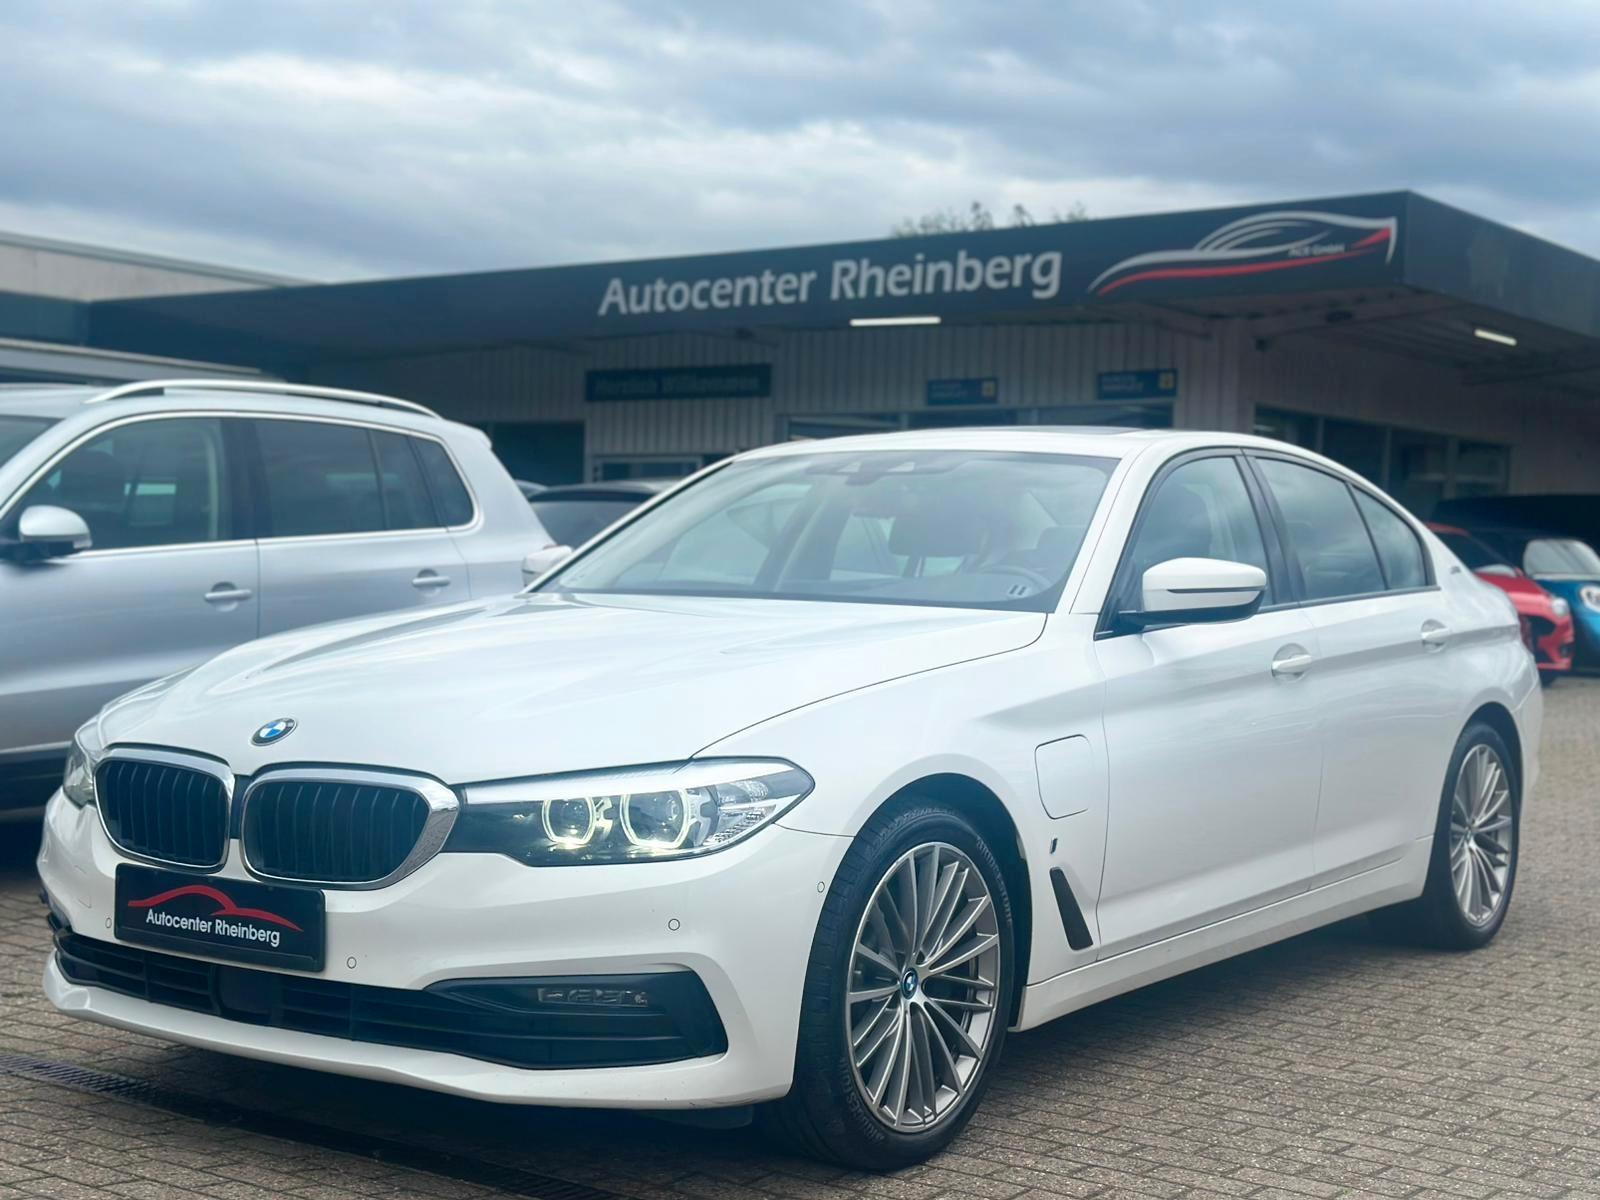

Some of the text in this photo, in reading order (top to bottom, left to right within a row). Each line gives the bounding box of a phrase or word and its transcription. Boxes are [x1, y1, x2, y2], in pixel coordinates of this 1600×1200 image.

[598, 249, 1063, 316] Autocenter Rheinberg
[146, 908, 281, 947] Autocenter Rheinberg
